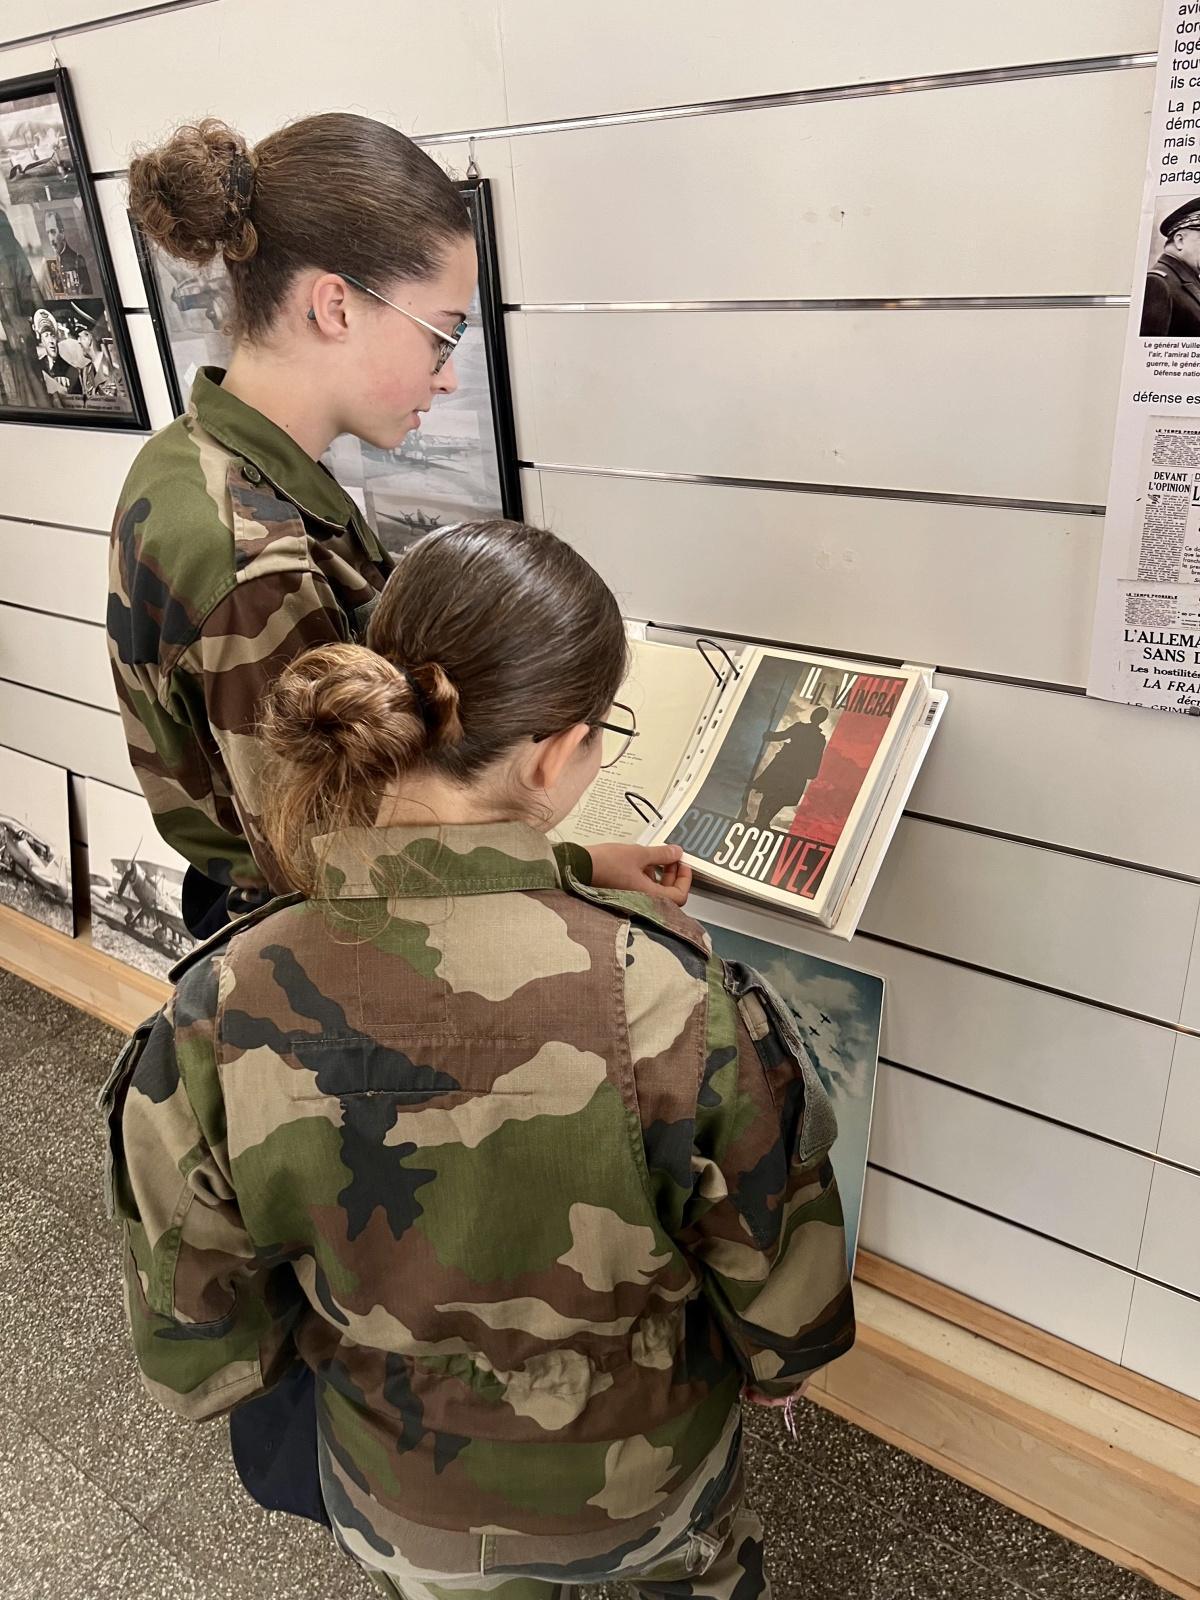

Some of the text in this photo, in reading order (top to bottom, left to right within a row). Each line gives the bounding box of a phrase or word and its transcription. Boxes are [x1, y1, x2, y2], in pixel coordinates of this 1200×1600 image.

[1176, 20, 1200, 34] dor
[1172, 59, 1200, 71] trou
[1170, 76, 1185, 89] ils
[1168, 99, 1184, 113] La
[1164, 134, 1196, 148] mais
[1161, 152, 1178, 166] de
[1159, 169, 1200, 186] partag
[1143, 341, 1153, 349] Le
[1153, 341, 1180, 350] général
[1153, 369, 1182, 377] Défense
[1132, 391, 1182, 404] défense
[1153, 471, 1188, 482] DEVANT
[1148, 481, 1191, 493] L'OPINION
[1143, 647, 1186, 663] SANS
[1130, 664, 1149, 674] Les
[800, 666, 823, 699] IL
[1143, 678, 1161, 690] LA
